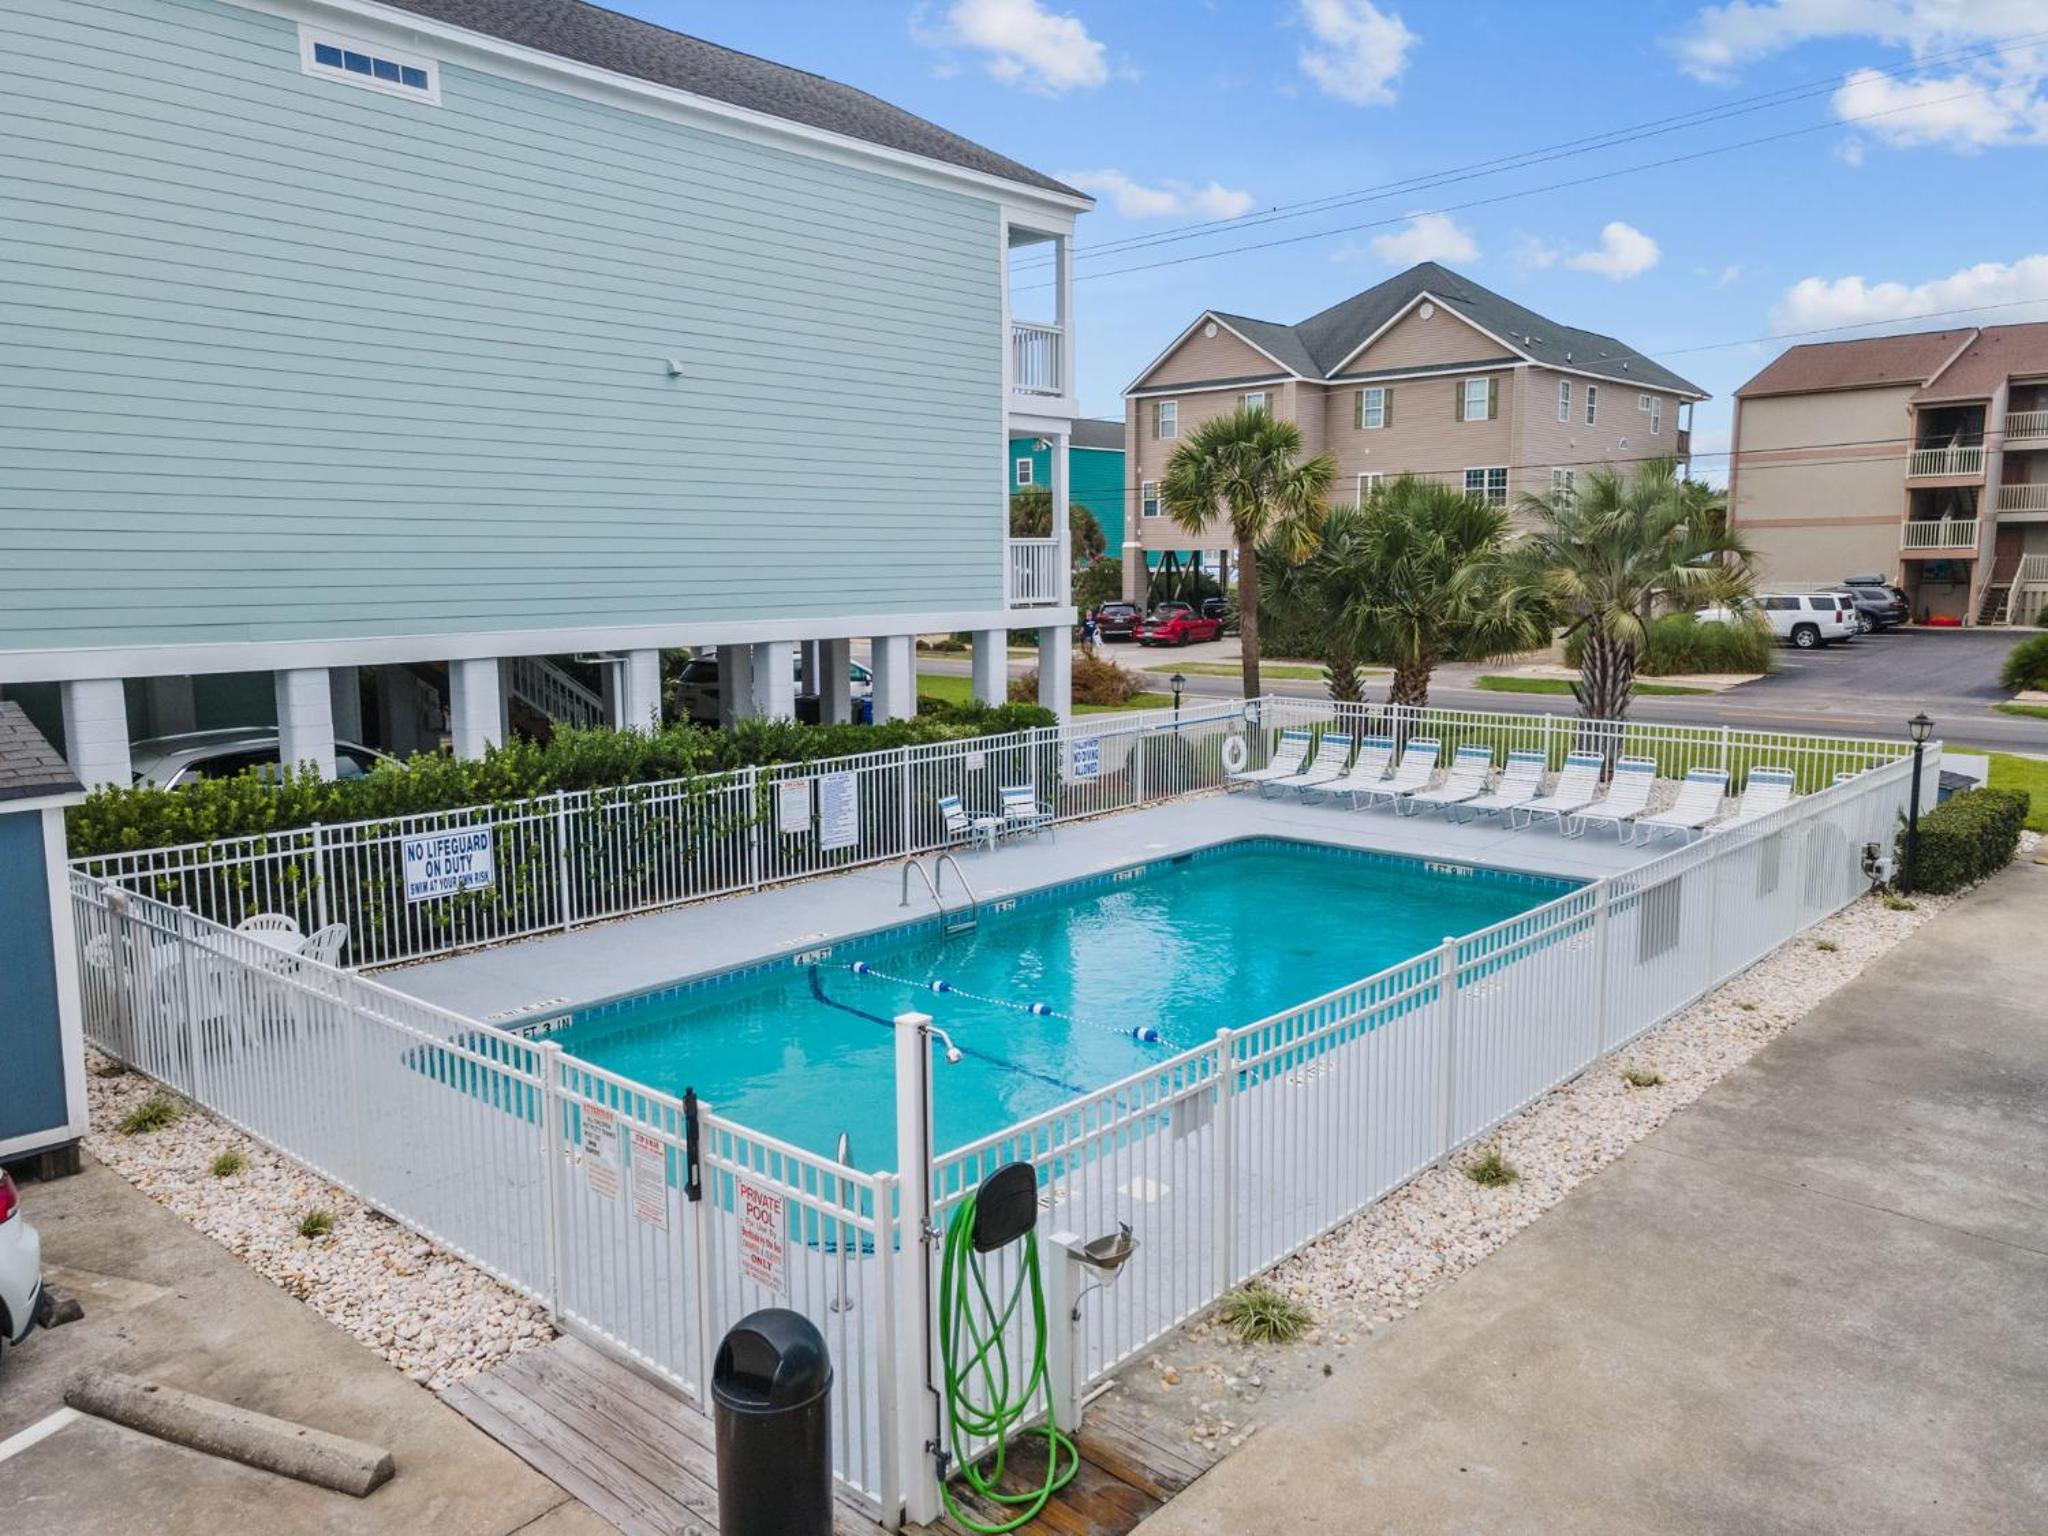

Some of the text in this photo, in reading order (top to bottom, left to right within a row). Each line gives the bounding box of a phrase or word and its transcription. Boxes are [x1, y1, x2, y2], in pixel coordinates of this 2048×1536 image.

[407, 834, 487, 862] NO LIFEGUARD
[426, 854, 473, 877] ON DUTY
[410, 881, 428, 896] SWIM
[429, 879, 438, 893] AT
[439, 875, 458, 890] YOUR
[474, 871, 489, 884] RISK
[522, 1026, 538, 1039] FT
[543, 1022, 552, 1033] 3
[557, 1017, 570, 1031] IN
[740, 1183, 782, 1216] PRIVATE
[746, 1202, 775, 1229] POOL
[751, 1253, 773, 1272] ONLY
